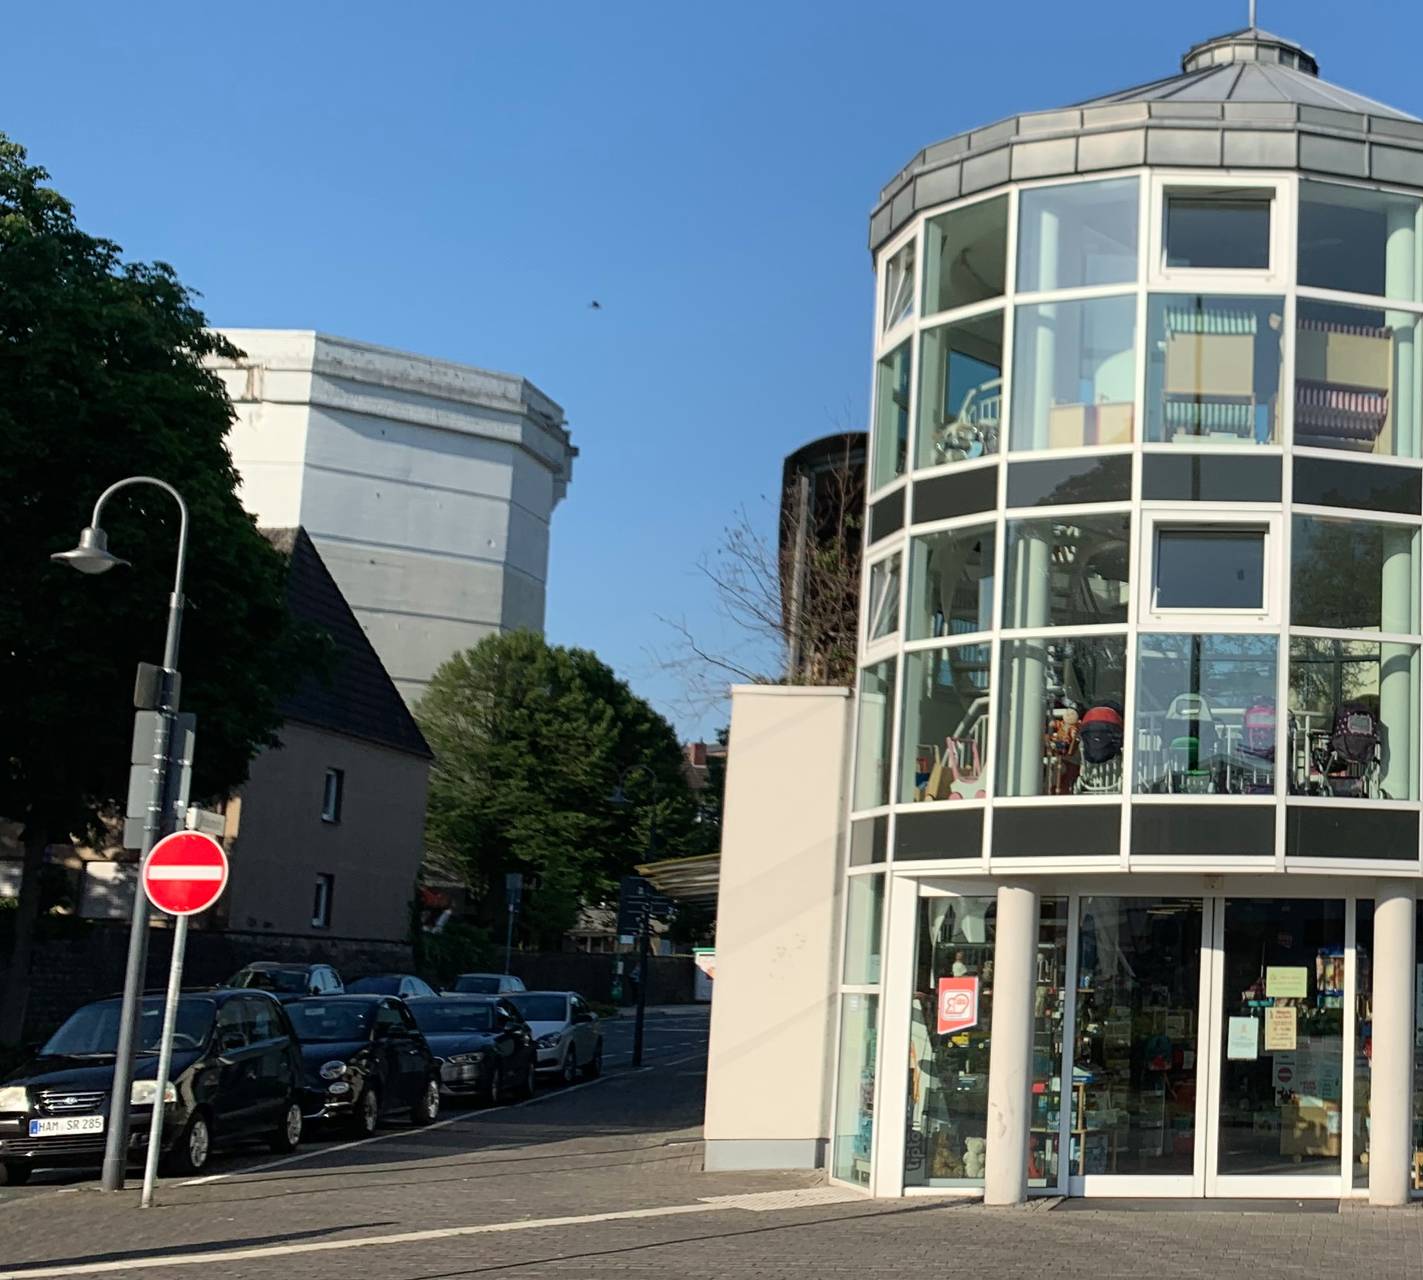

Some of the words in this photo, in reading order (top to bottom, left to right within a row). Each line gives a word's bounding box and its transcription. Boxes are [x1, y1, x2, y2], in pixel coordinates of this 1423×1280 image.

[39, 1121, 59, 1132] HAM
[66, 1119, 80, 1131] SR
[82, 1118, 102, 1130] 285
